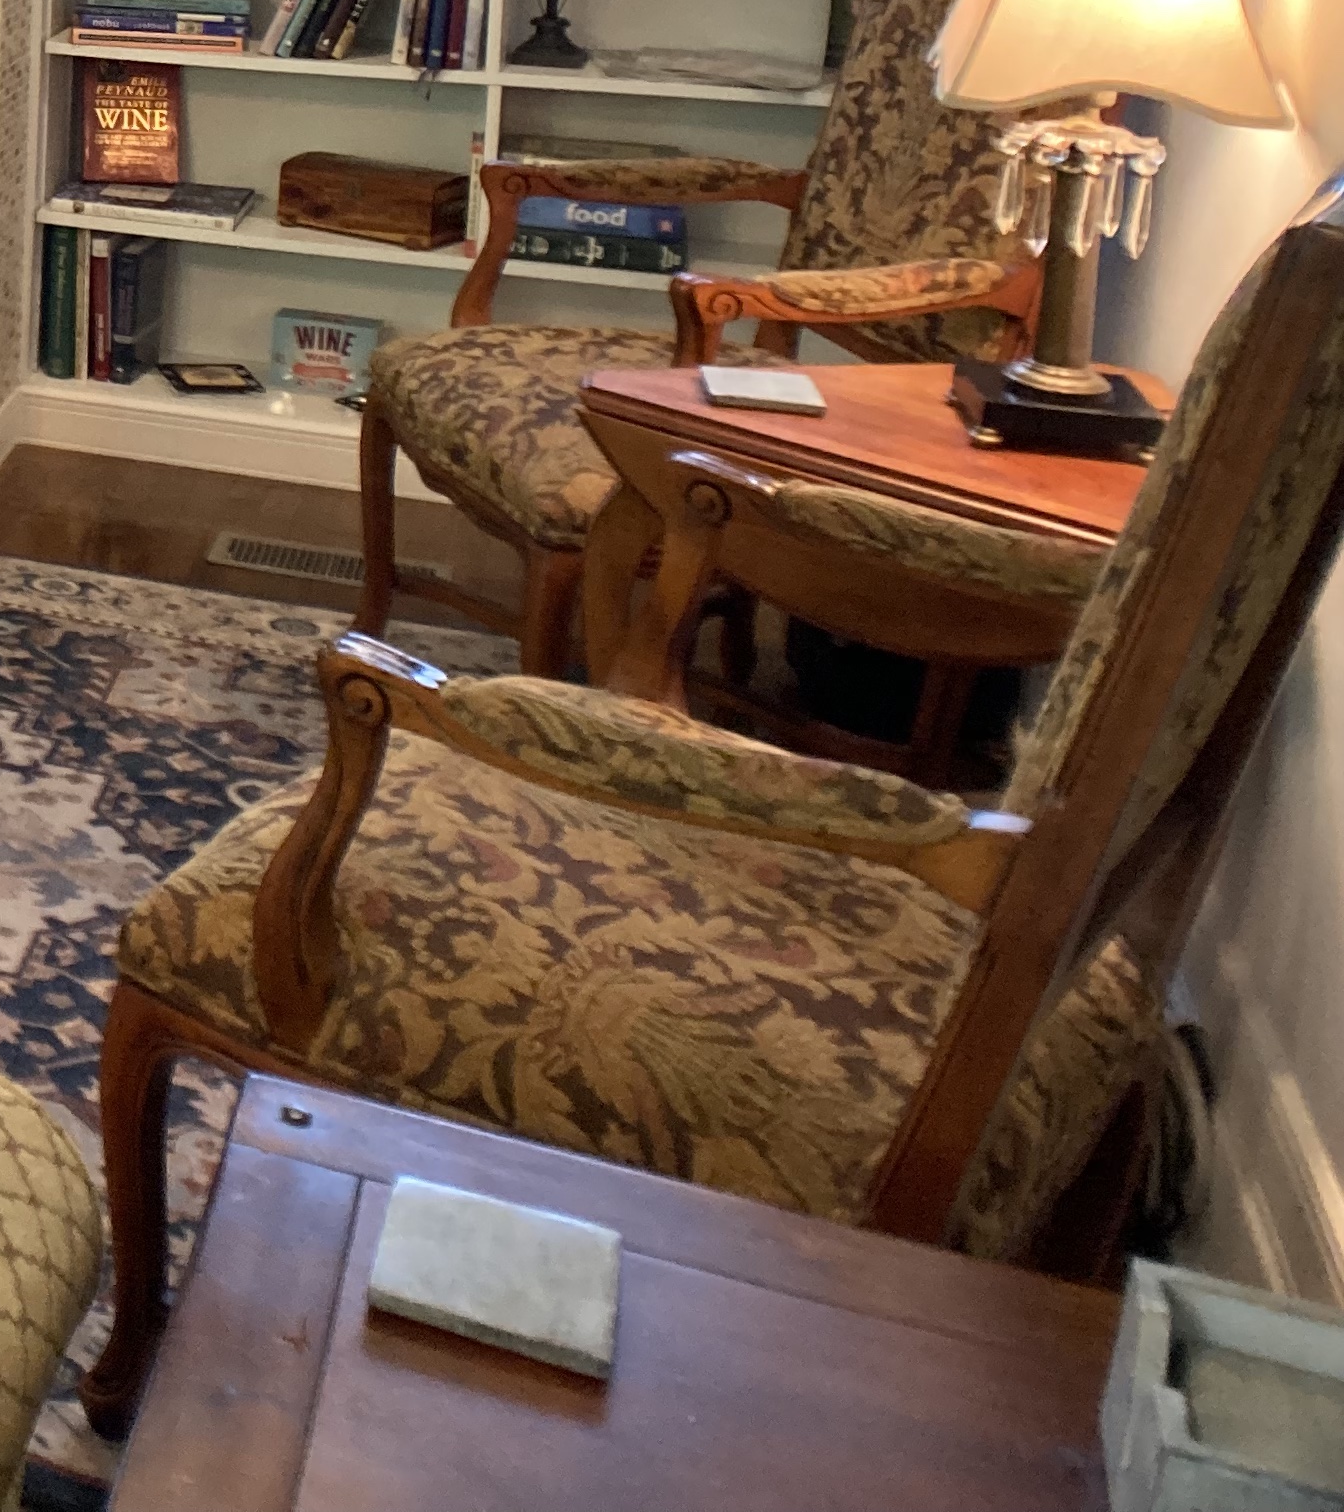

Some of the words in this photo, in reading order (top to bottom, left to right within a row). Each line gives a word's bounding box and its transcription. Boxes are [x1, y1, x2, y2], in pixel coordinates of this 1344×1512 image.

[96, 85, 169, 97] PEYNAUD
[95, 98, 116, 108] THE
[119, 99, 151, 109] TASTE
[154, 100, 169, 108] OF
[95, 108, 169, 132] WINE
[566, 202, 628, 228] food
[294, 326, 358, 357] WINE
